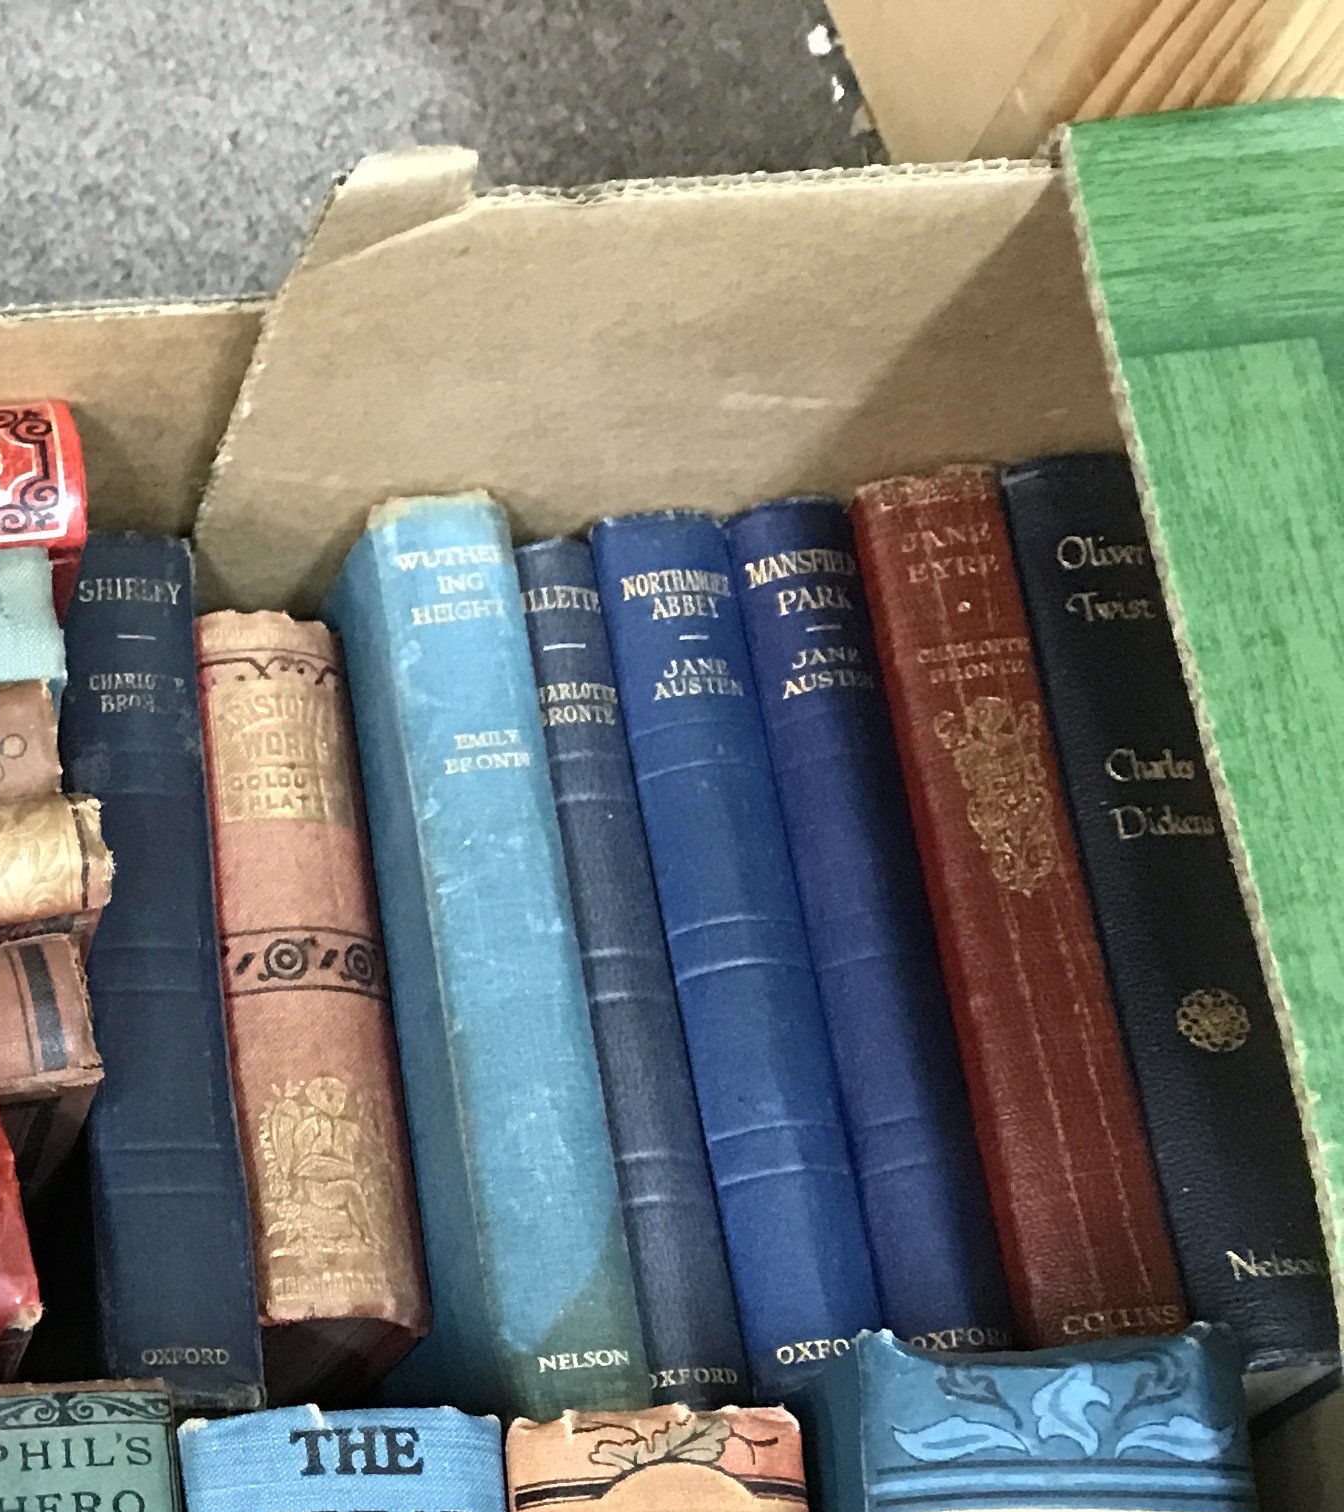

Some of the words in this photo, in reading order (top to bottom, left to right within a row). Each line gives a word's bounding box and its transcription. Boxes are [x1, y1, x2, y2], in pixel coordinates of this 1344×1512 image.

[901, 521, 994, 554] JANE
[1056, 534, 1146, 570] Oliver
[436, 572, 485, 595] ING
[744, 548, 856, 589] MANSFIELD
[907, 552, 1000, 584] EYRE
[78, 576, 183, 606] SHIRLEY
[620, 567, 732, 602] NORTHANGER
[652, 594, 719, 621] ABBEY
[776, 585, 853, 617] PARK
[1064, 590, 1158, 623] Twist
[792, 645, 862, 671] JANE
[916, 636, 1031, 664] CHARLOTTE
[663, 657, 728, 680] JANE
[653, 676, 745, 701] AUSTEN
[782, 669, 875, 700] AUSTEN
[453, 728, 522, 751] EMILY
[1104, 747, 1196, 783] Charles
[1110, 804, 1216, 841] Dickens
[1062, 1303, 1181, 1337] COLLINS
[140, 1347, 231, 1367] OXFORD
[537, 1349, 631, 1374] NELSON
[288, 1424, 425, 1477] THE
